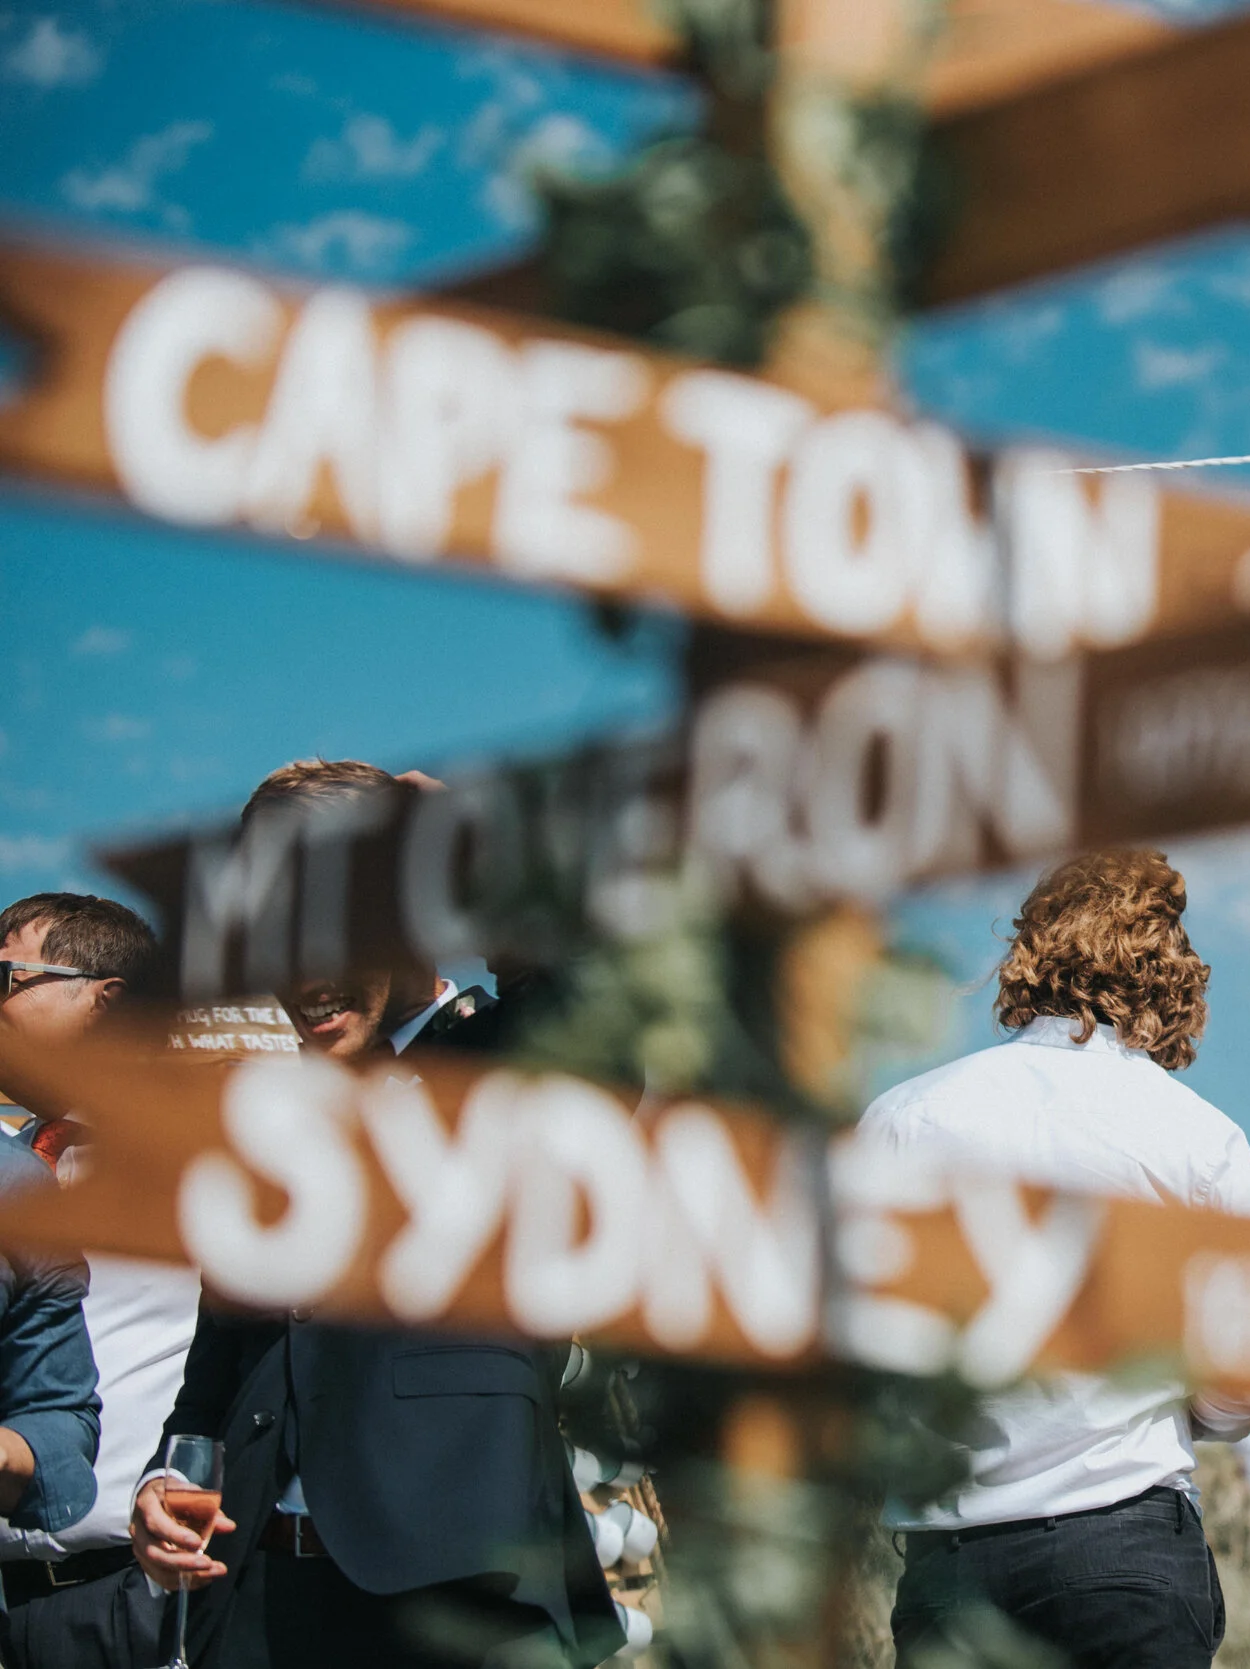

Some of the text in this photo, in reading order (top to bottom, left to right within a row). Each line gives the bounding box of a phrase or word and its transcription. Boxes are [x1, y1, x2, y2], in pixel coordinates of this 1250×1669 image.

[105, 265, 1160, 662] CAPE TOWN
[404, 652, 1082, 960] OERON
[187, 1033, 235, 1050] WHAT
[239, 1033, 299, 1052] TASTES
[212, 1006, 247, 1023] FOR
[243, 1007, 277, 1025] THE
[178, 1056, 1102, 1390] SYDNEY
